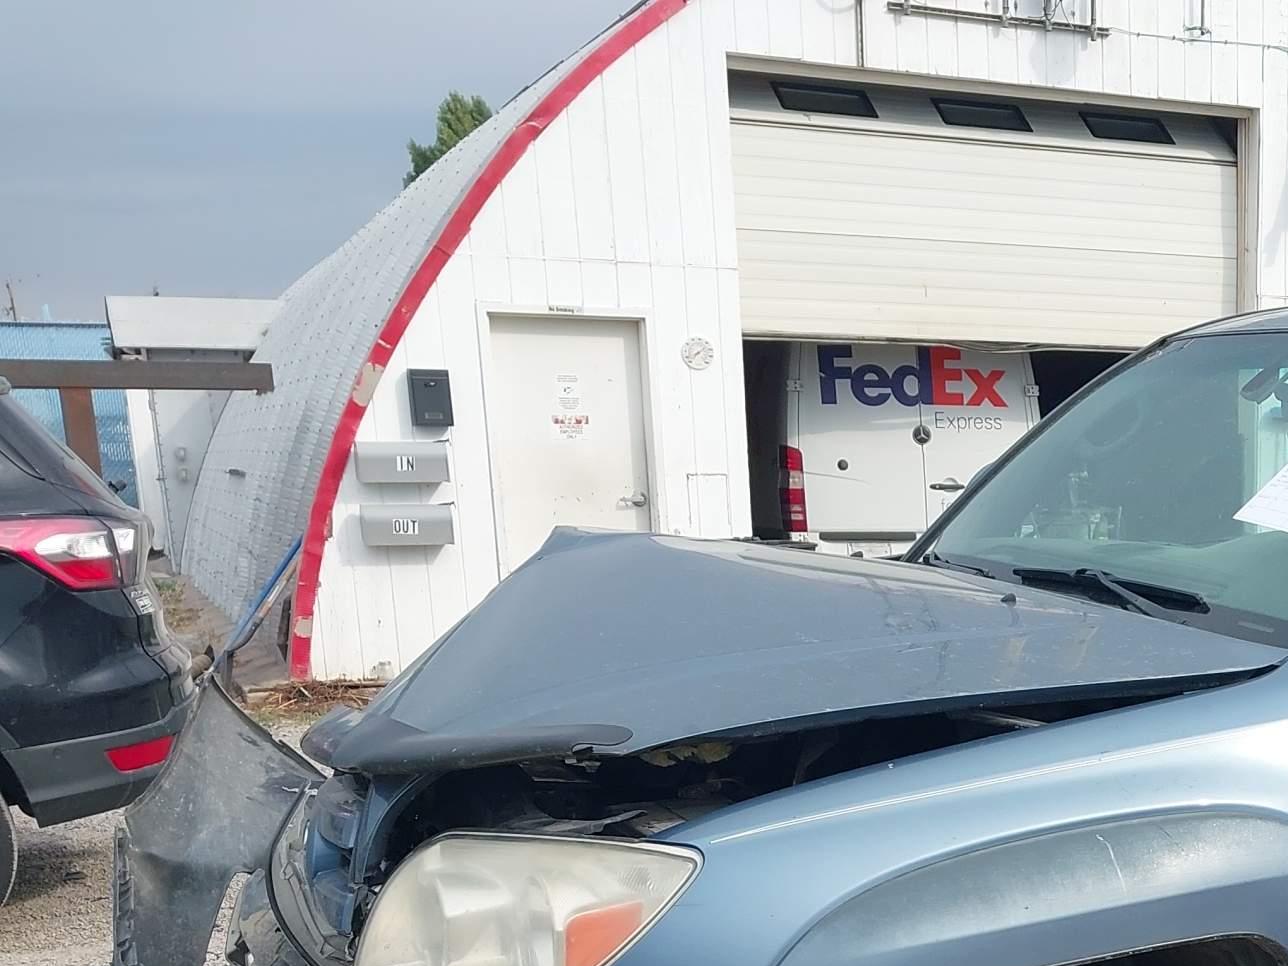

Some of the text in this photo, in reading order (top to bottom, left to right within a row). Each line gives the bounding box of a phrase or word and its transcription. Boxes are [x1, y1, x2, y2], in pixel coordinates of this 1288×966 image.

[817, 344, 1008, 408] FedEx
[934, 411, 1003, 433] Express
[400, 455, 415, 472] IN
[393, 519, 418, 534] OUT
